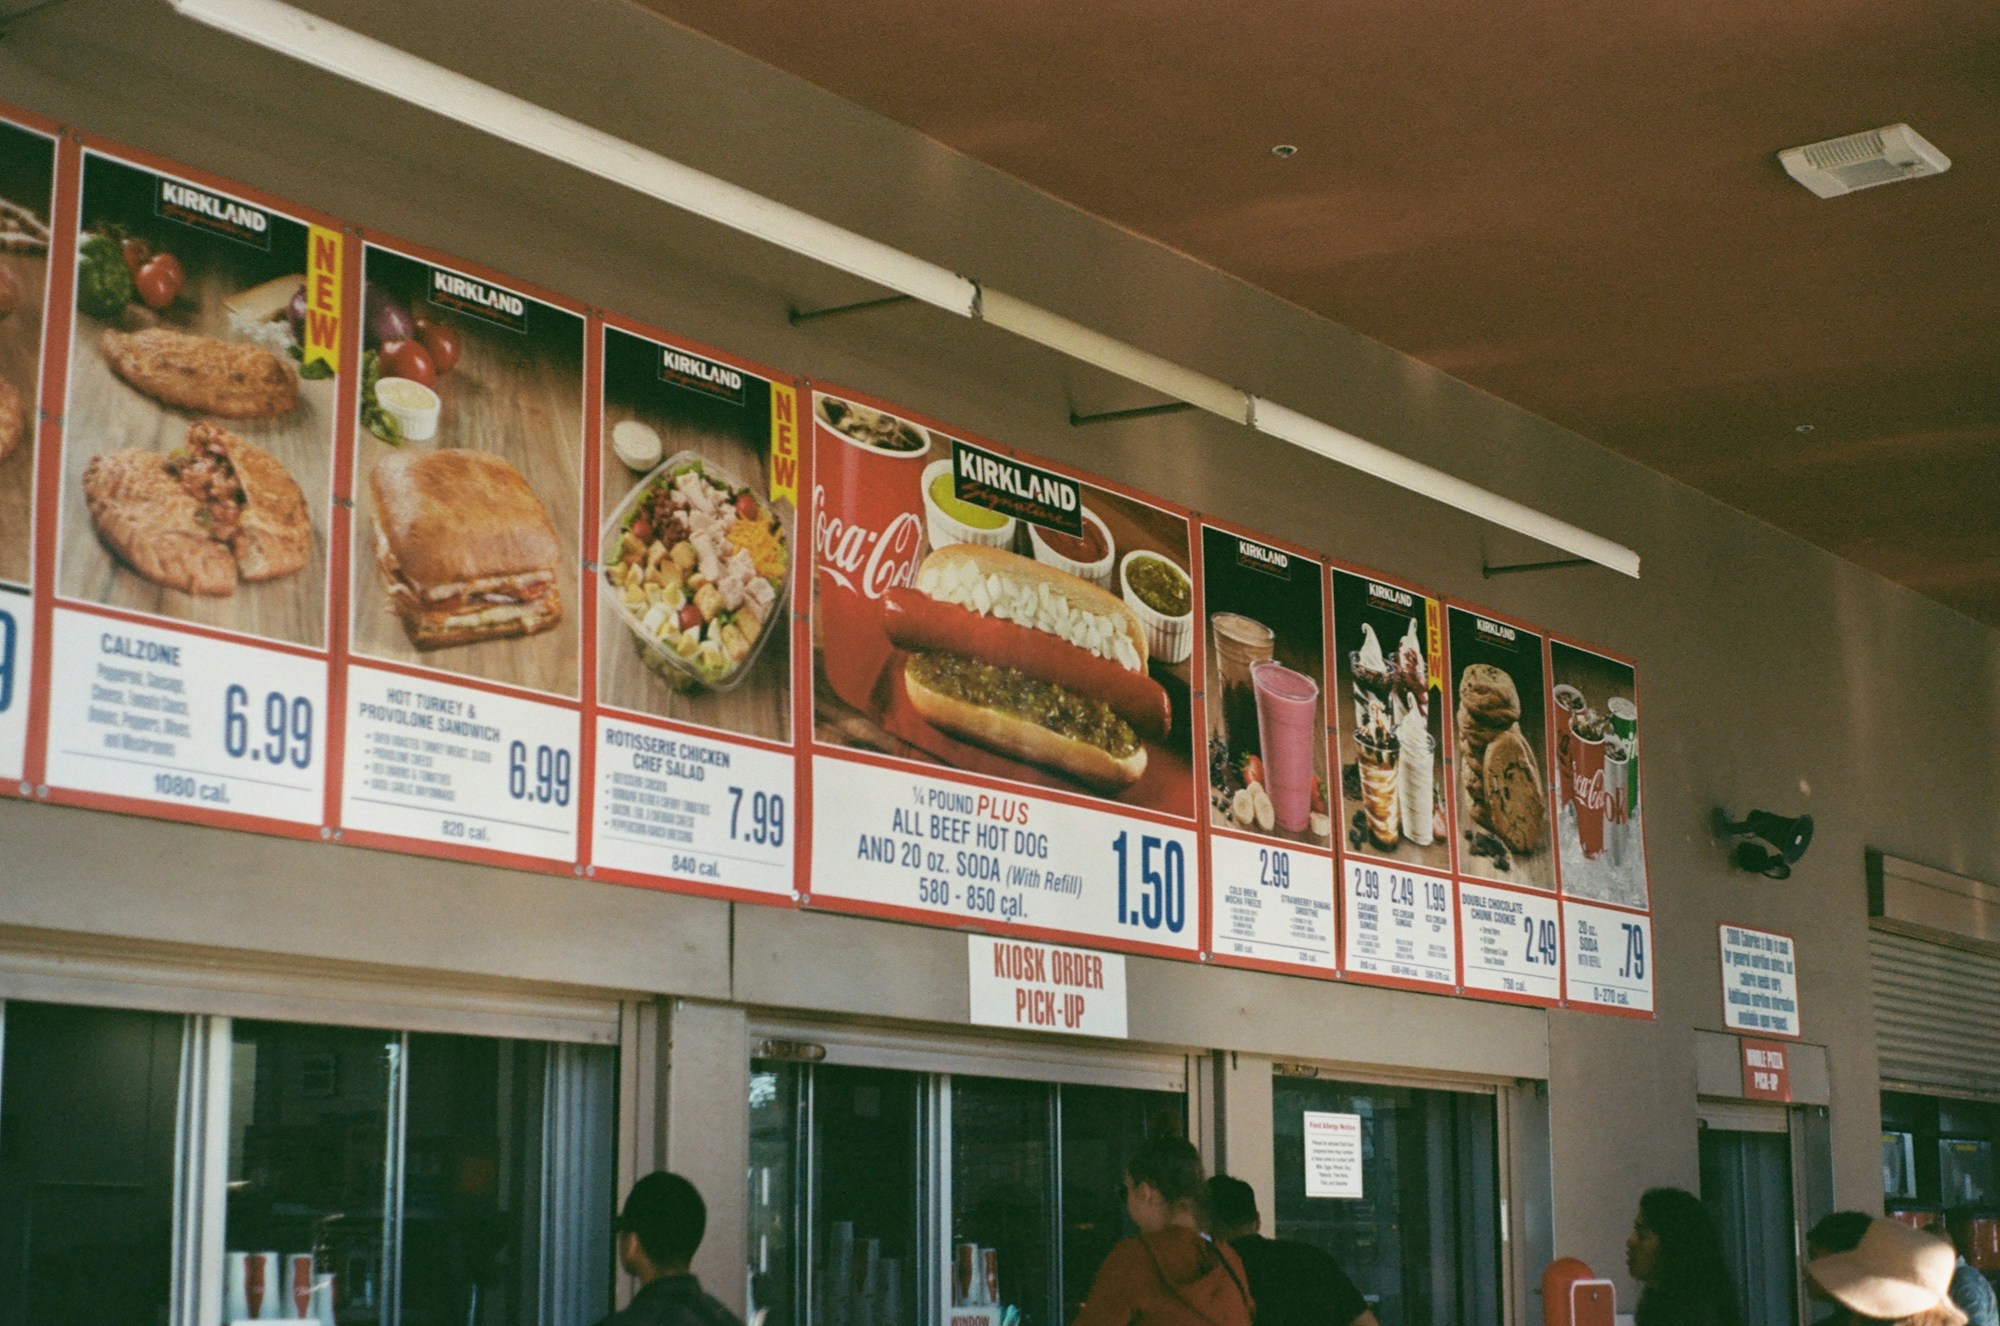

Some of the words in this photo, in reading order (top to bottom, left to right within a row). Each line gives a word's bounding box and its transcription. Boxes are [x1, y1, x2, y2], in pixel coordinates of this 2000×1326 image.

[162, 182, 267, 232] KIRKLAND
[309, 235, 337, 350] NEW
[435, 272, 523, 316] KIRKLAND
[664, 351, 742, 390] KIRKLAND
[773, 392, 795, 489] NEW
[959, 449, 1077, 512] KIRKLAND
[1239, 541, 1288, 568] KIRKLAND
[1369, 583, 1412, 607] KIRKLAND
[1428, 604, 1440, 678] NEW
[1476, 618, 1515, 641] KIRKLAND
[101, 633, 181, 666] CALZONE
[359, 702, 434, 731] PROVOLONE
[437, 717, 501, 743] SANDWICH
[387, 688, 411, 705] HOT
[417, 693, 463, 716] TURKEY
[467, 704, 476, 719] &
[225, 684, 313, 769] 6.99
[606, 728, 677, 758] ROTISSERIE
[680, 743, 730, 768] CHICKEN
[633, 753, 663, 772] CHEF
[665, 759, 705, 782] SALAD
[154, 773, 195, 799] 1080
[200, 783, 230, 804] cal.
[509, 740, 571, 807] 6.99
[728, 786, 784, 848] 7.99
[928, 788, 973, 815] POUND
[977, 794, 1029, 826] PLUS
[442, 820, 464, 838] 820
[468, 826, 490, 842] cal.
[892, 807, 924, 838] ALL
[930, 815, 971, 844] BEEF
[977, 824, 1008, 852] HOT
[1014, 832, 1048, 860] DOG
[672, 854, 695, 874] 840
[699, 860, 720, 878] cal.
[857, 834, 895, 865] AND
[901, 841, 922, 869] 20
[927, 853, 950, 874] oz.
[956, 851, 1000, 883] SODA
[1005, 865, 1041, 889] (With
[1044, 871, 1083, 900] Refill)
[1112, 830, 1185, 934] 1.50
[1259, 848, 1290, 889] 2.99
[1355, 867, 1379, 900] 2.99
[918, 877, 949, 906] 580
[966, 885, 995, 914] 850
[1000, 893, 1028, 919] cal.
[1244, 898, 1262, 909] FREEZE
[1281, 894, 1312, 908] STRAWBERRY
[1390, 874, 1414, 906] 2.49
[1424, 881, 1446, 912] 1.99
[1462, 893, 1487, 908] DOUBLE
[1488, 898, 1523, 914] CHOCOLATE
[1471, 909, 1493, 922] CHUNK
[1494, 913, 1516, 926] COOKIE
[1578, 920, 1587, 935] 20
[1589, 925, 1598, 936] oz.
[1524, 916, 1556, 966] 2.49
[1579, 936, 1599, 952] SODA
[1619, 923, 1645, 979] .79
[993, 942, 1046, 981] KIOSK
[1051, 951, 1104, 990] ORDER
[1015, 987, 1085, 1029] PICK-UP
